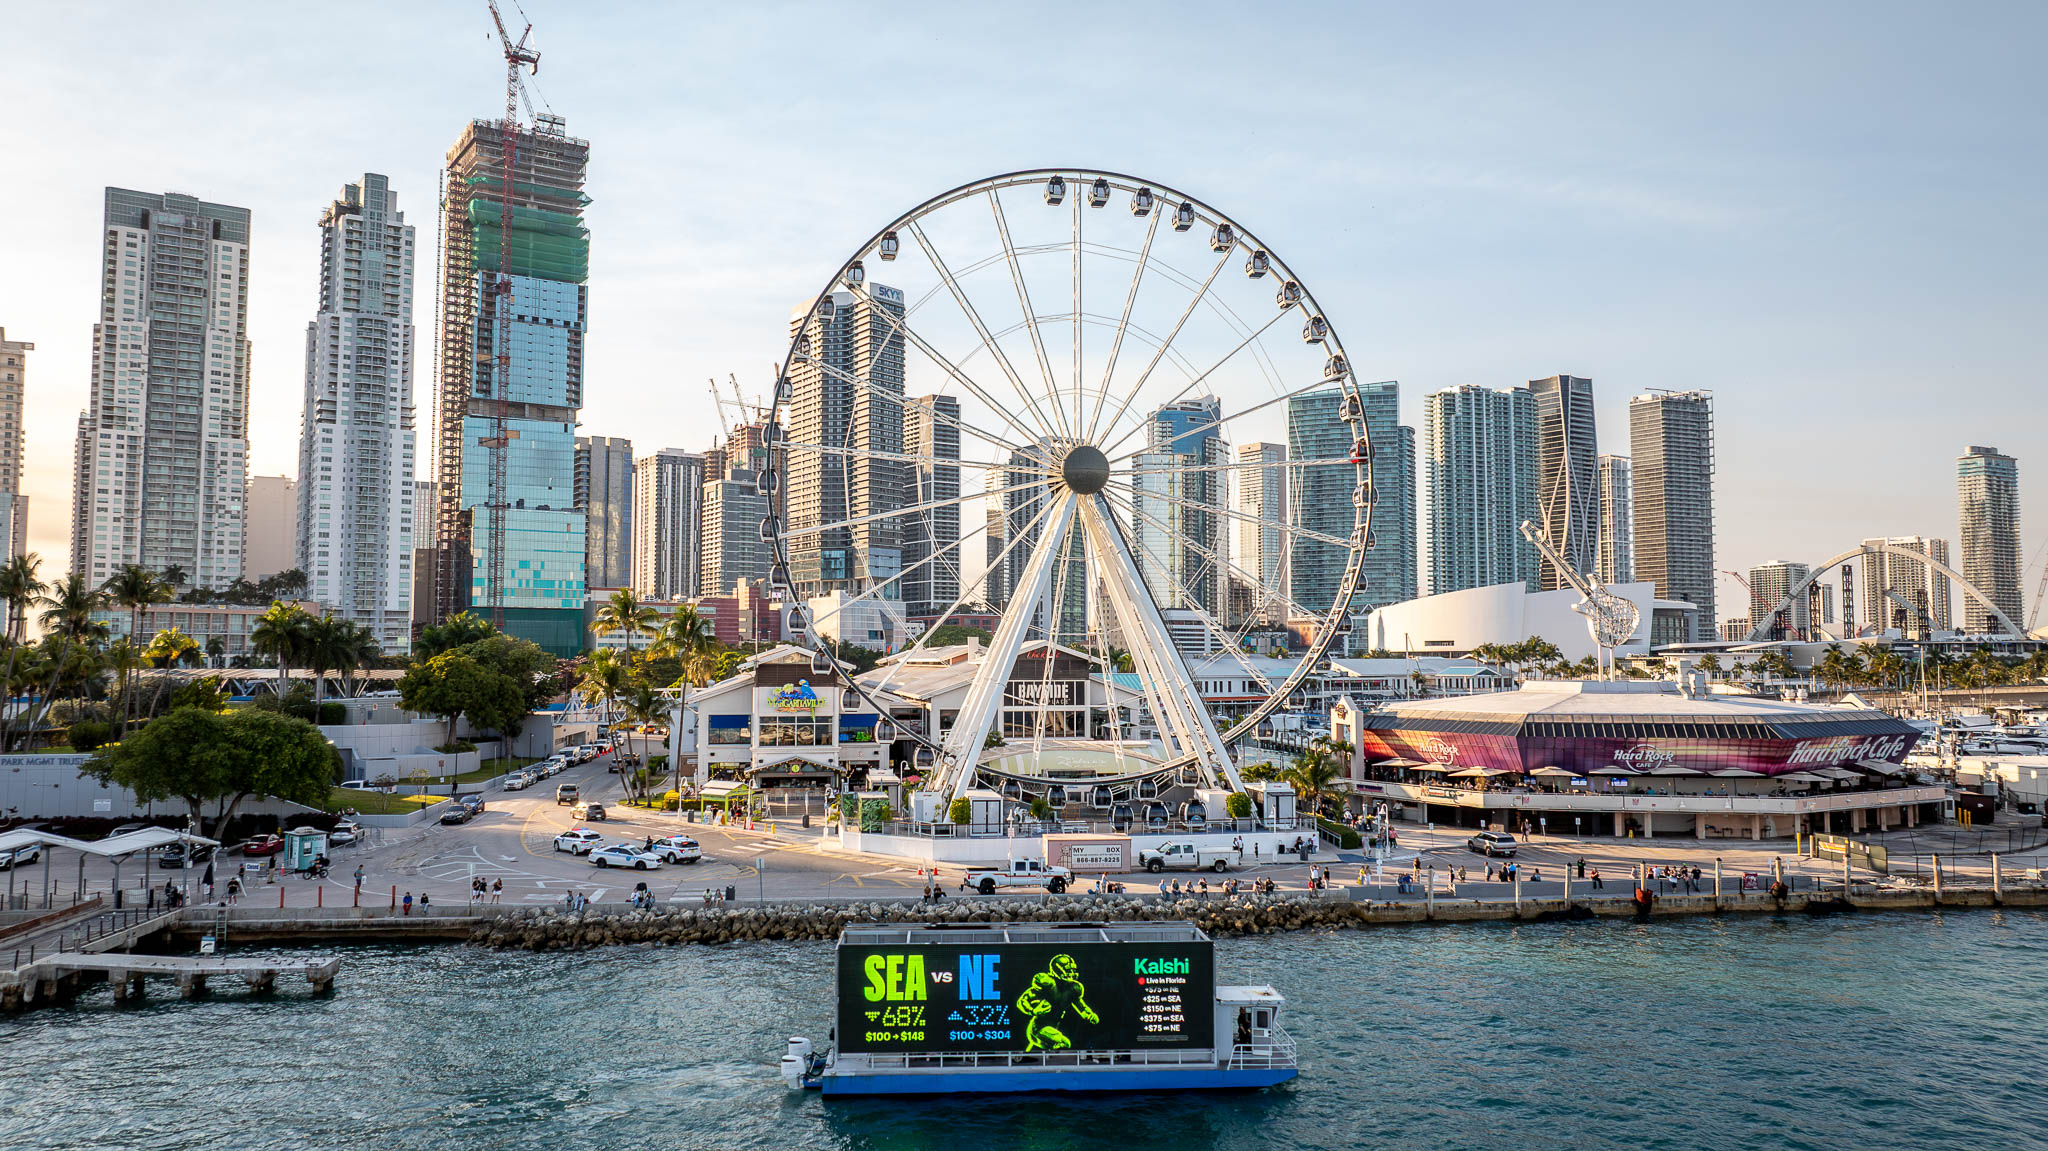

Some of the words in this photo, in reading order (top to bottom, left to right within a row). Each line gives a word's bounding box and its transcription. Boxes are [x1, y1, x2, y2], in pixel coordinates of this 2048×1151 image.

[879, 286, 901, 300] SKYX
[1419, 742, 1438, 753] Hard
[1438, 743, 1459, 756] Rock
[1614, 749, 1645, 760] Hard
[1645, 750, 1674, 762] Rock
[1786, 740, 1836, 763] Hard
[1829, 738, 1872, 765] Rock
[1868, 735, 1905, 760] Cafe
[26, 757, 54, 765] MGMT
[57, 757, 84, 765] TRUST
[1134, 958, 1189, 974] Kalshi
[864, 955, 927, 1002] SEA
[959, 955, 1000, 1001] NE
[1143, 995, 1160, 1003] +$25
[1168, 995, 1182, 1003] SEA
[882, 1006, 926, 1027] 68%
[965, 1005, 1010, 1026] 32%
[865, 1031, 891, 1042] $100
[900, 1031, 925, 1042] $148
[950, 1030, 975, 1041] $100
[984, 1030, 1011, 1041] $304
